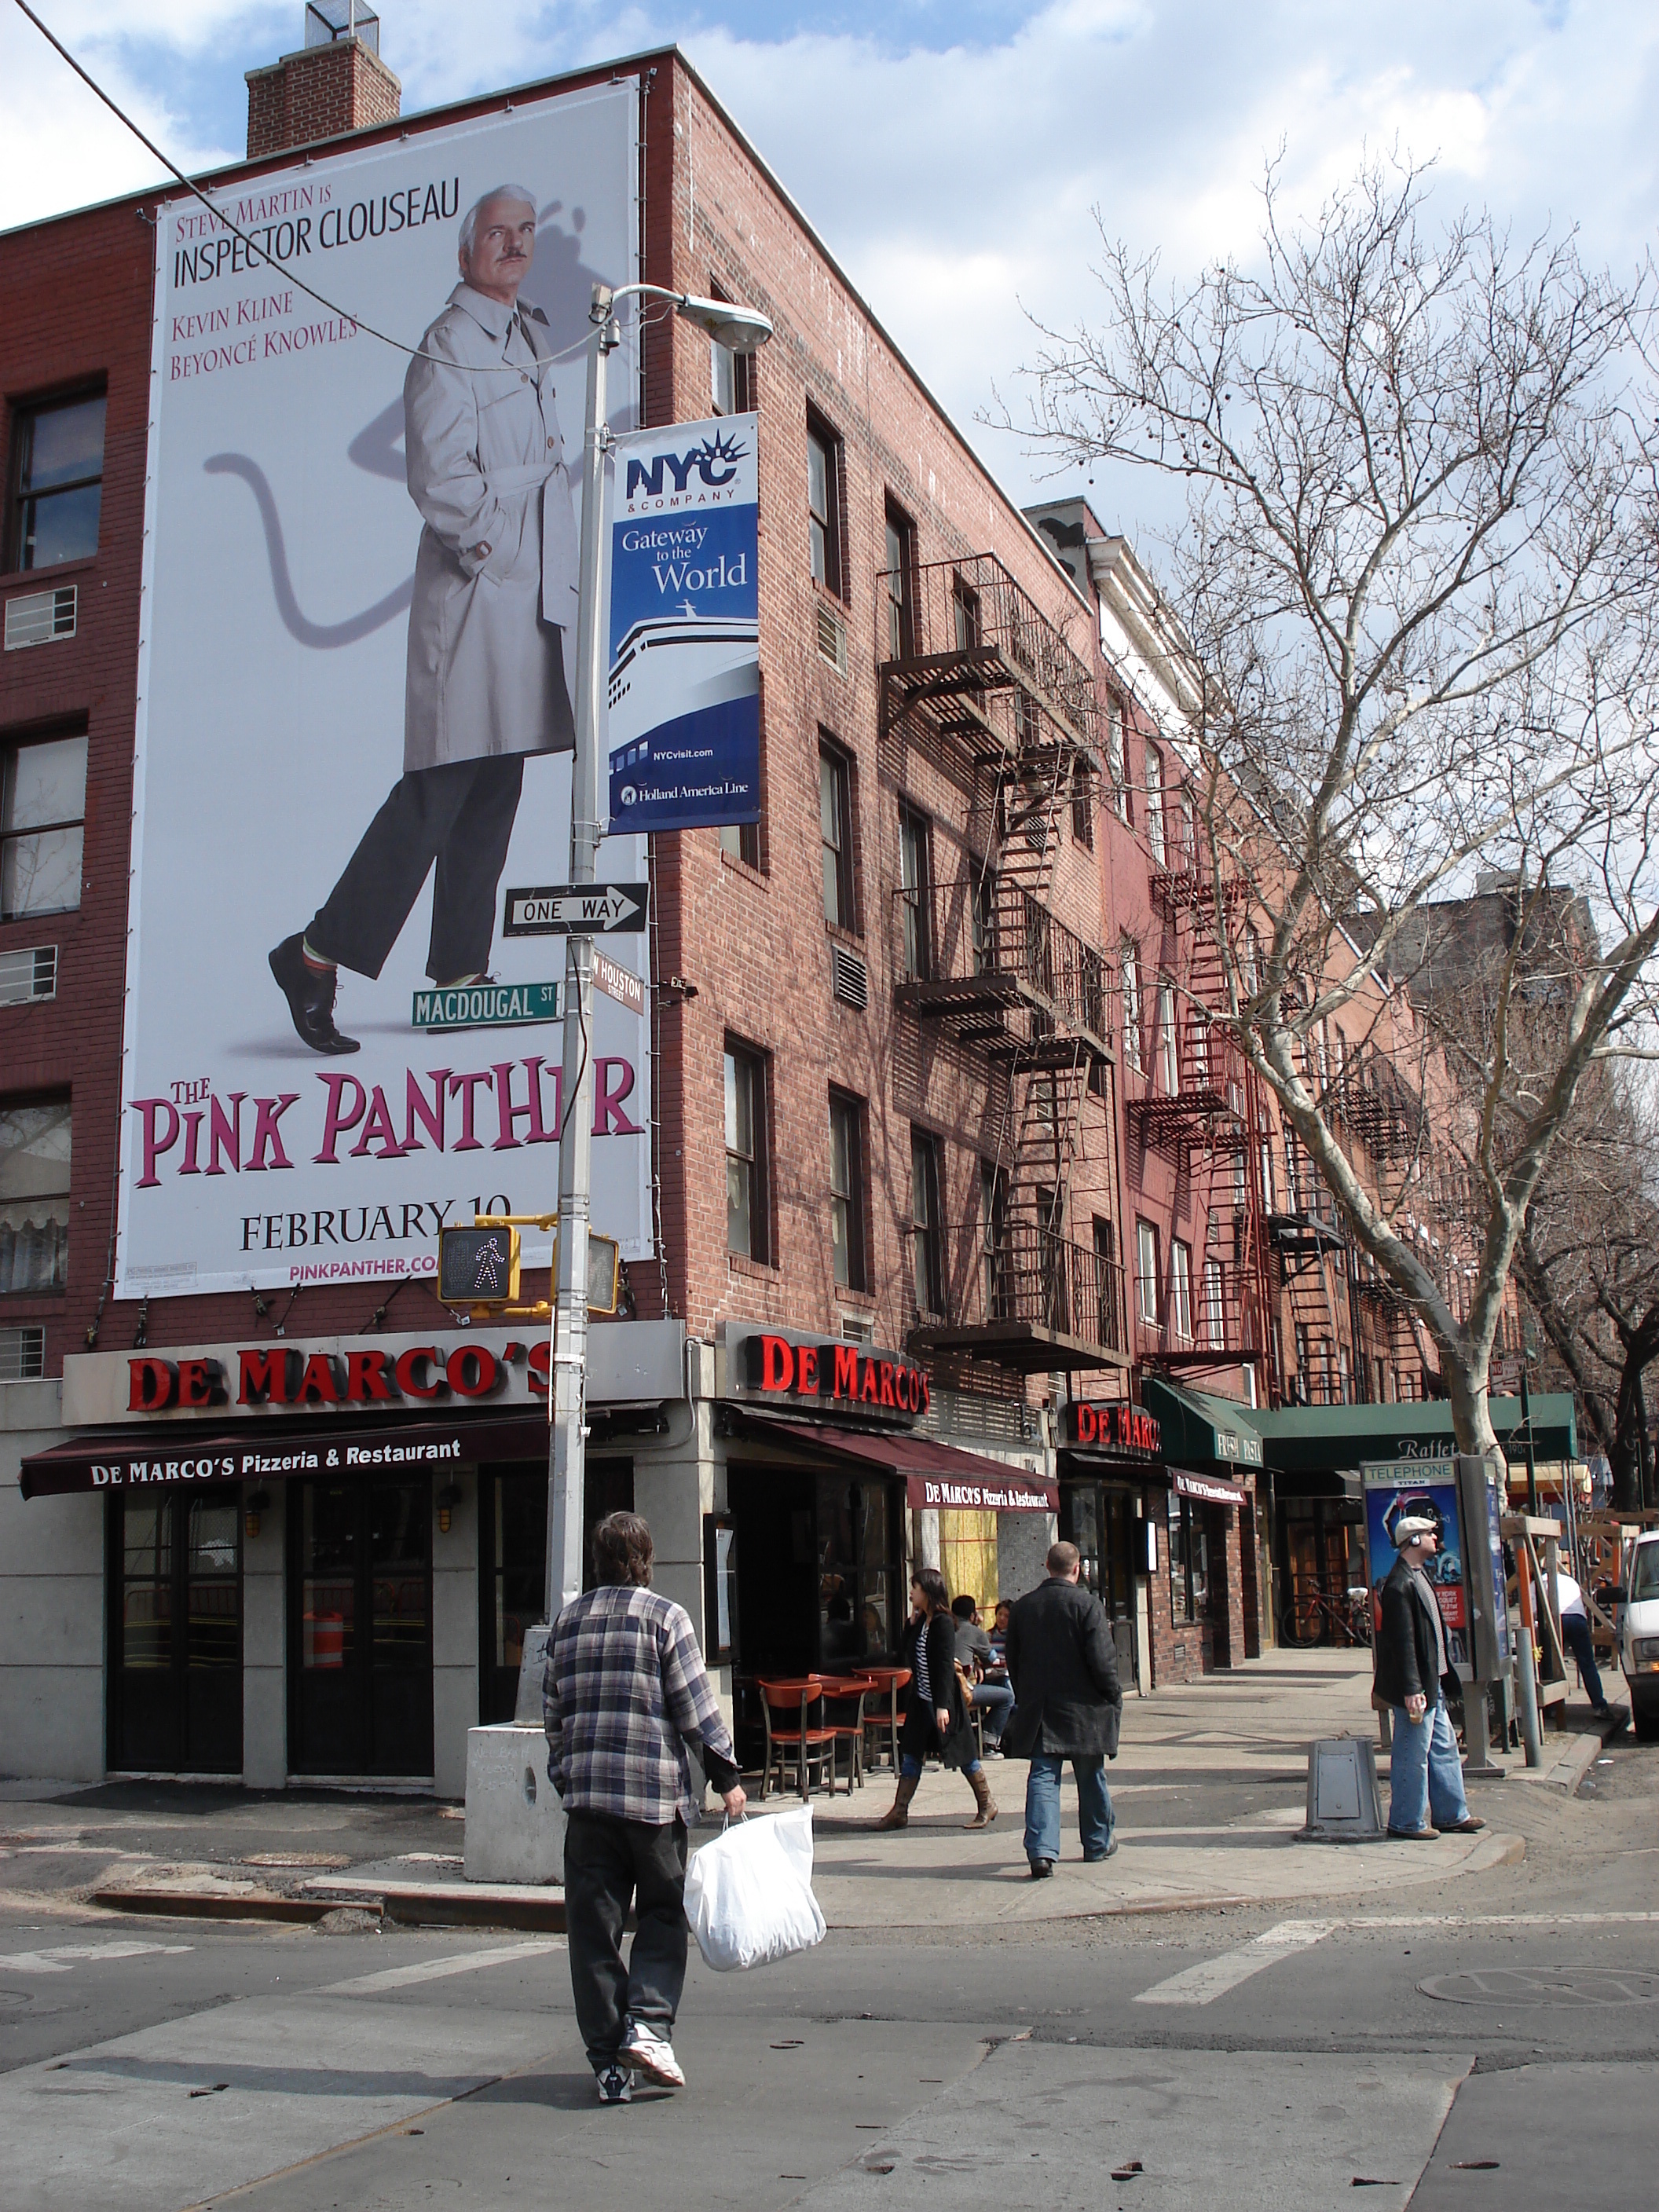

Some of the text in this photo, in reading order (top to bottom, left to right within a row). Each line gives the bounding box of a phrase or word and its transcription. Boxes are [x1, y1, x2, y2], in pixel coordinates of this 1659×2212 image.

[174, 177, 460, 288] INSPECTOR CLOUSEAU
[175, 185, 331, 245] STEVE MARTIN IS
[171, 291, 293, 342] KEVIN KLINE
[170, 314, 357, 381] BEYONCÉ KNOWLES
[626, 441, 740, 500] NYC
[628, 489, 735, 513] & COMPANY
[622, 527, 709, 551] Gateway
[657, 546, 691, 562] to the
[651, 552, 748, 594] World
[654, 749, 713, 760] NYCvisit.com
[639, 782, 749, 802] Holland America Line
[523, 899, 624, 921] ONE WAY
[601, 958, 641, 1002] HOUSTON
[608, 983, 624, 1001] STREET
[416, 986, 553, 1023] MACDOUGAL ST
[170, 1078, 211, 1104] THE
[127, 1091, 302, 1189] PINK
[239, 1199, 455, 1251] FEBRUARY
[290, 1256, 439, 1281] PINKPANTHER.CO
[126, 1357, 223, 1412] DE
[761, 1335, 819, 1395] DE
[1078, 1403, 1111, 1444] DE
[91, 1439, 461, 1485] DE MARCO'S Pizzeria & Restaurant
[1368, 1463, 1451, 1480] TELEPHONE
[925, 1481, 941, 1503] DE
[941, 1482, 981, 1505] MARCO'S
